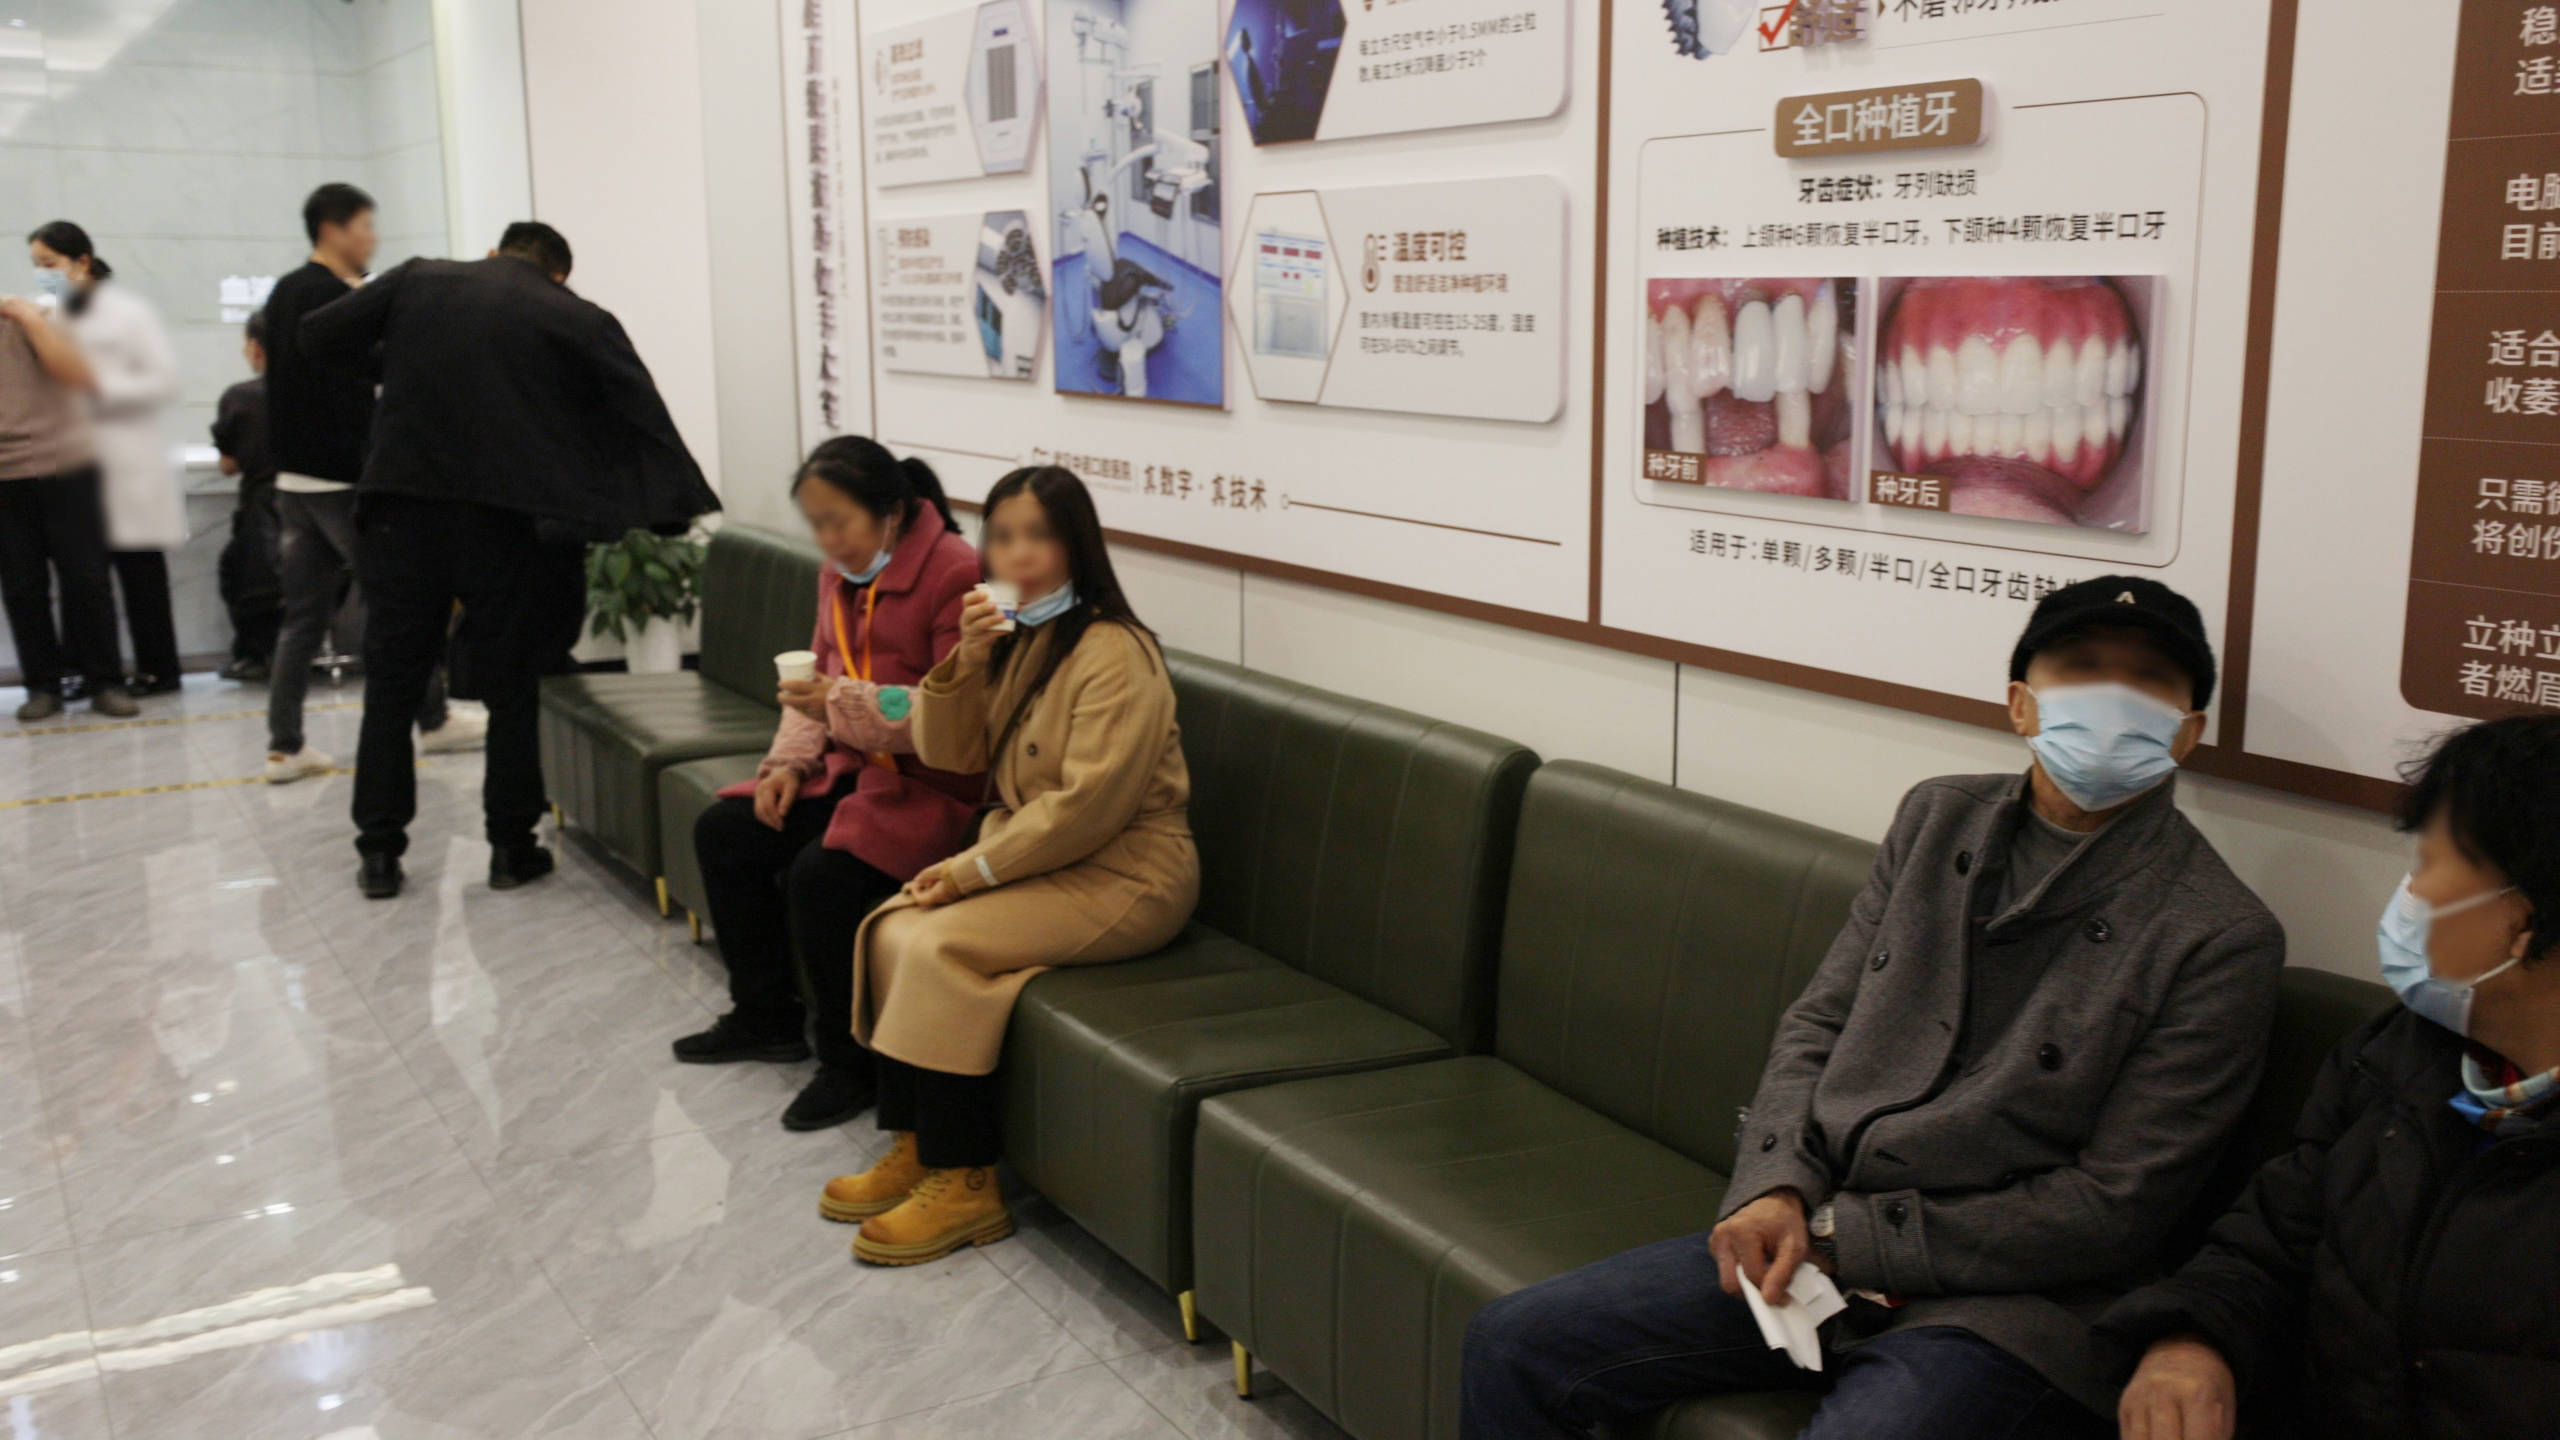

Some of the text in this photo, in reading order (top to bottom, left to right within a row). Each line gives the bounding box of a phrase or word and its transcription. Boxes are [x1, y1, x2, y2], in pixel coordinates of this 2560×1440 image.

[2513, 56, 2560, 95] 适
[1792, 91, 1958, 146] 全口种植牙
[1393, 230, 1467, 263] 温度可控
[2487, 329, 2560, 368] 适合
[2483, 376, 2560, 416] 收萎
[1646, 453, 1699, 481] 种牙前
[1876, 474, 1942, 507] 种牙后
[1689, 528, 2078, 603] 适用于:单颗/多颗/半口/全口牙齿缺
[2462, 614, 2560, 661] 立种立
[2458, 660, 2560, 709] 者燃眉
